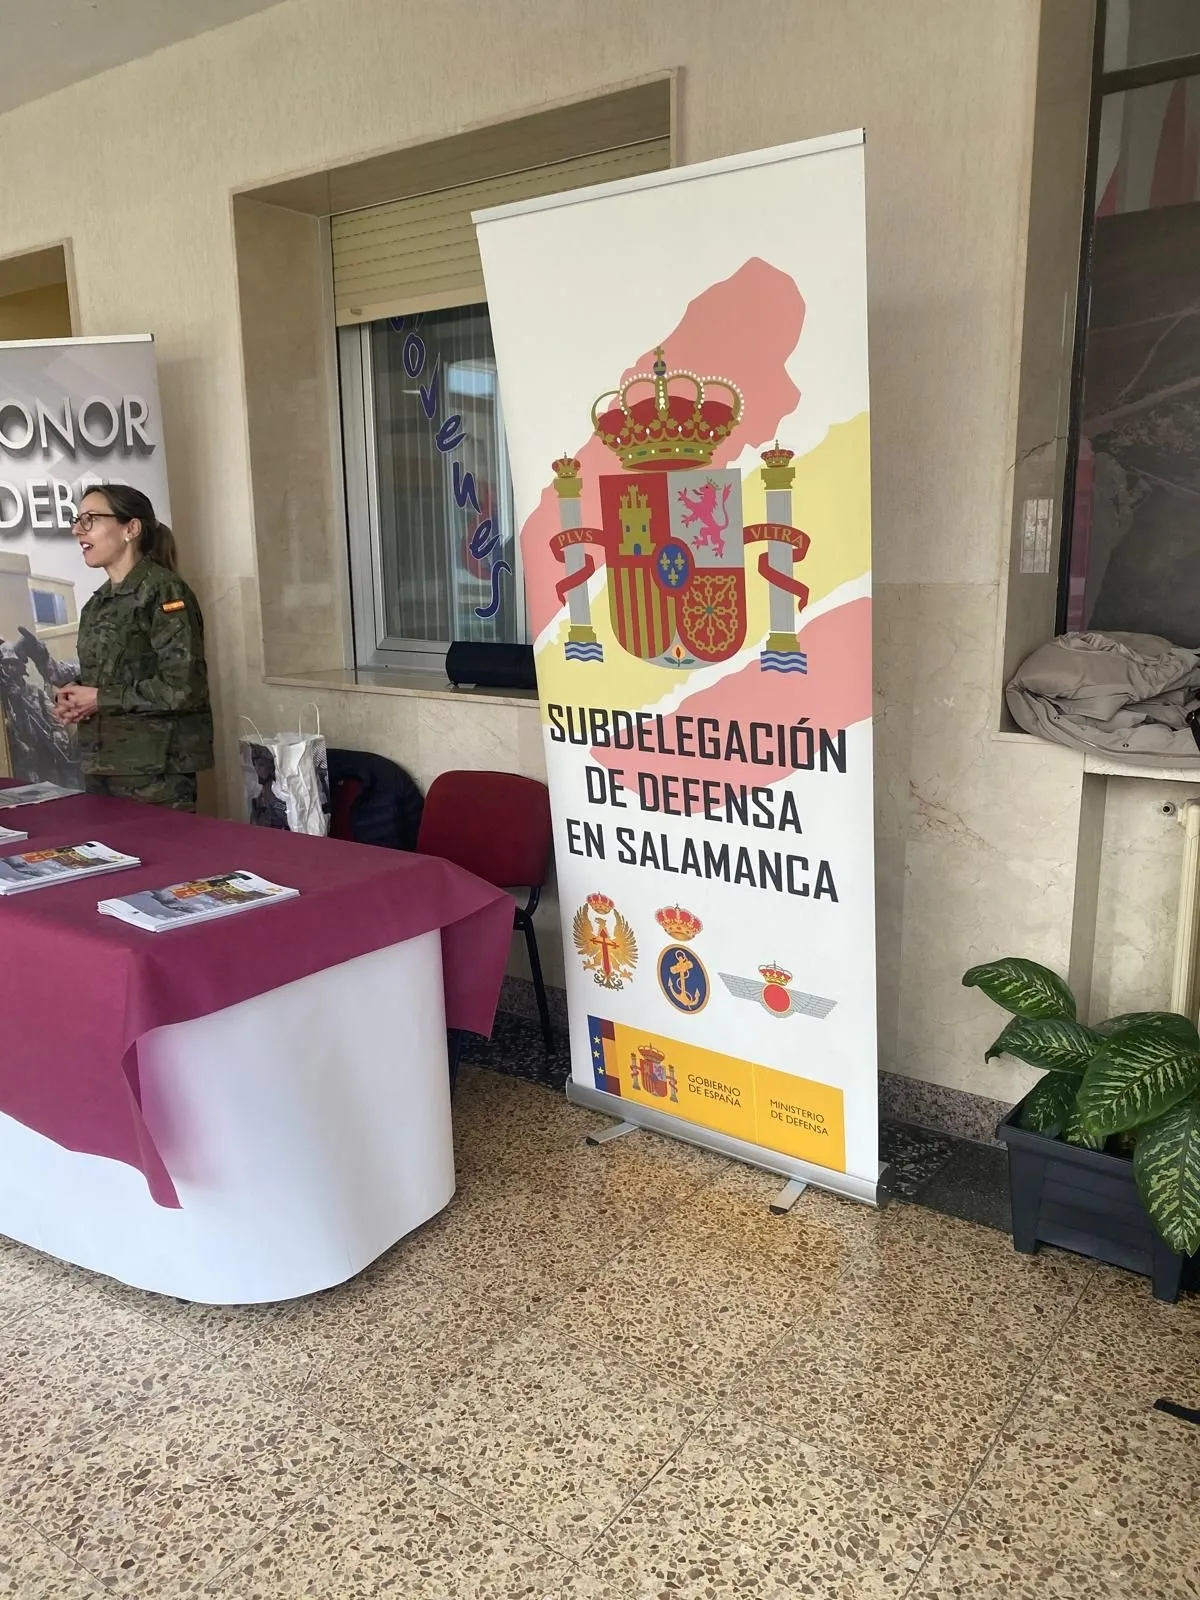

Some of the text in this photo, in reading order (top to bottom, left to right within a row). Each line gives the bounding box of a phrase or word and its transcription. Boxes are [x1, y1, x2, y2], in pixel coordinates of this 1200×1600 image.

[0, 395, 156, 450] ONOR
[390, 314, 512, 618] ovenes
[0, 477, 130, 529] DEB
[558, 526, 803, 548] PLVS VLTRA
[548, 703, 847, 774] SUBDELEGACIÓN
[585, 765, 803, 834] DE DEFENSA
[566, 818, 839, 903] EN SALAMANCA
[687, 1073, 741, 1097] GOBIERNO
[688, 1083, 741, 1108] DE ESPAÑA
[769, 1099, 825, 1124] MINISTERIO
[770, 1109, 829, 1137] DE DEFENSA
